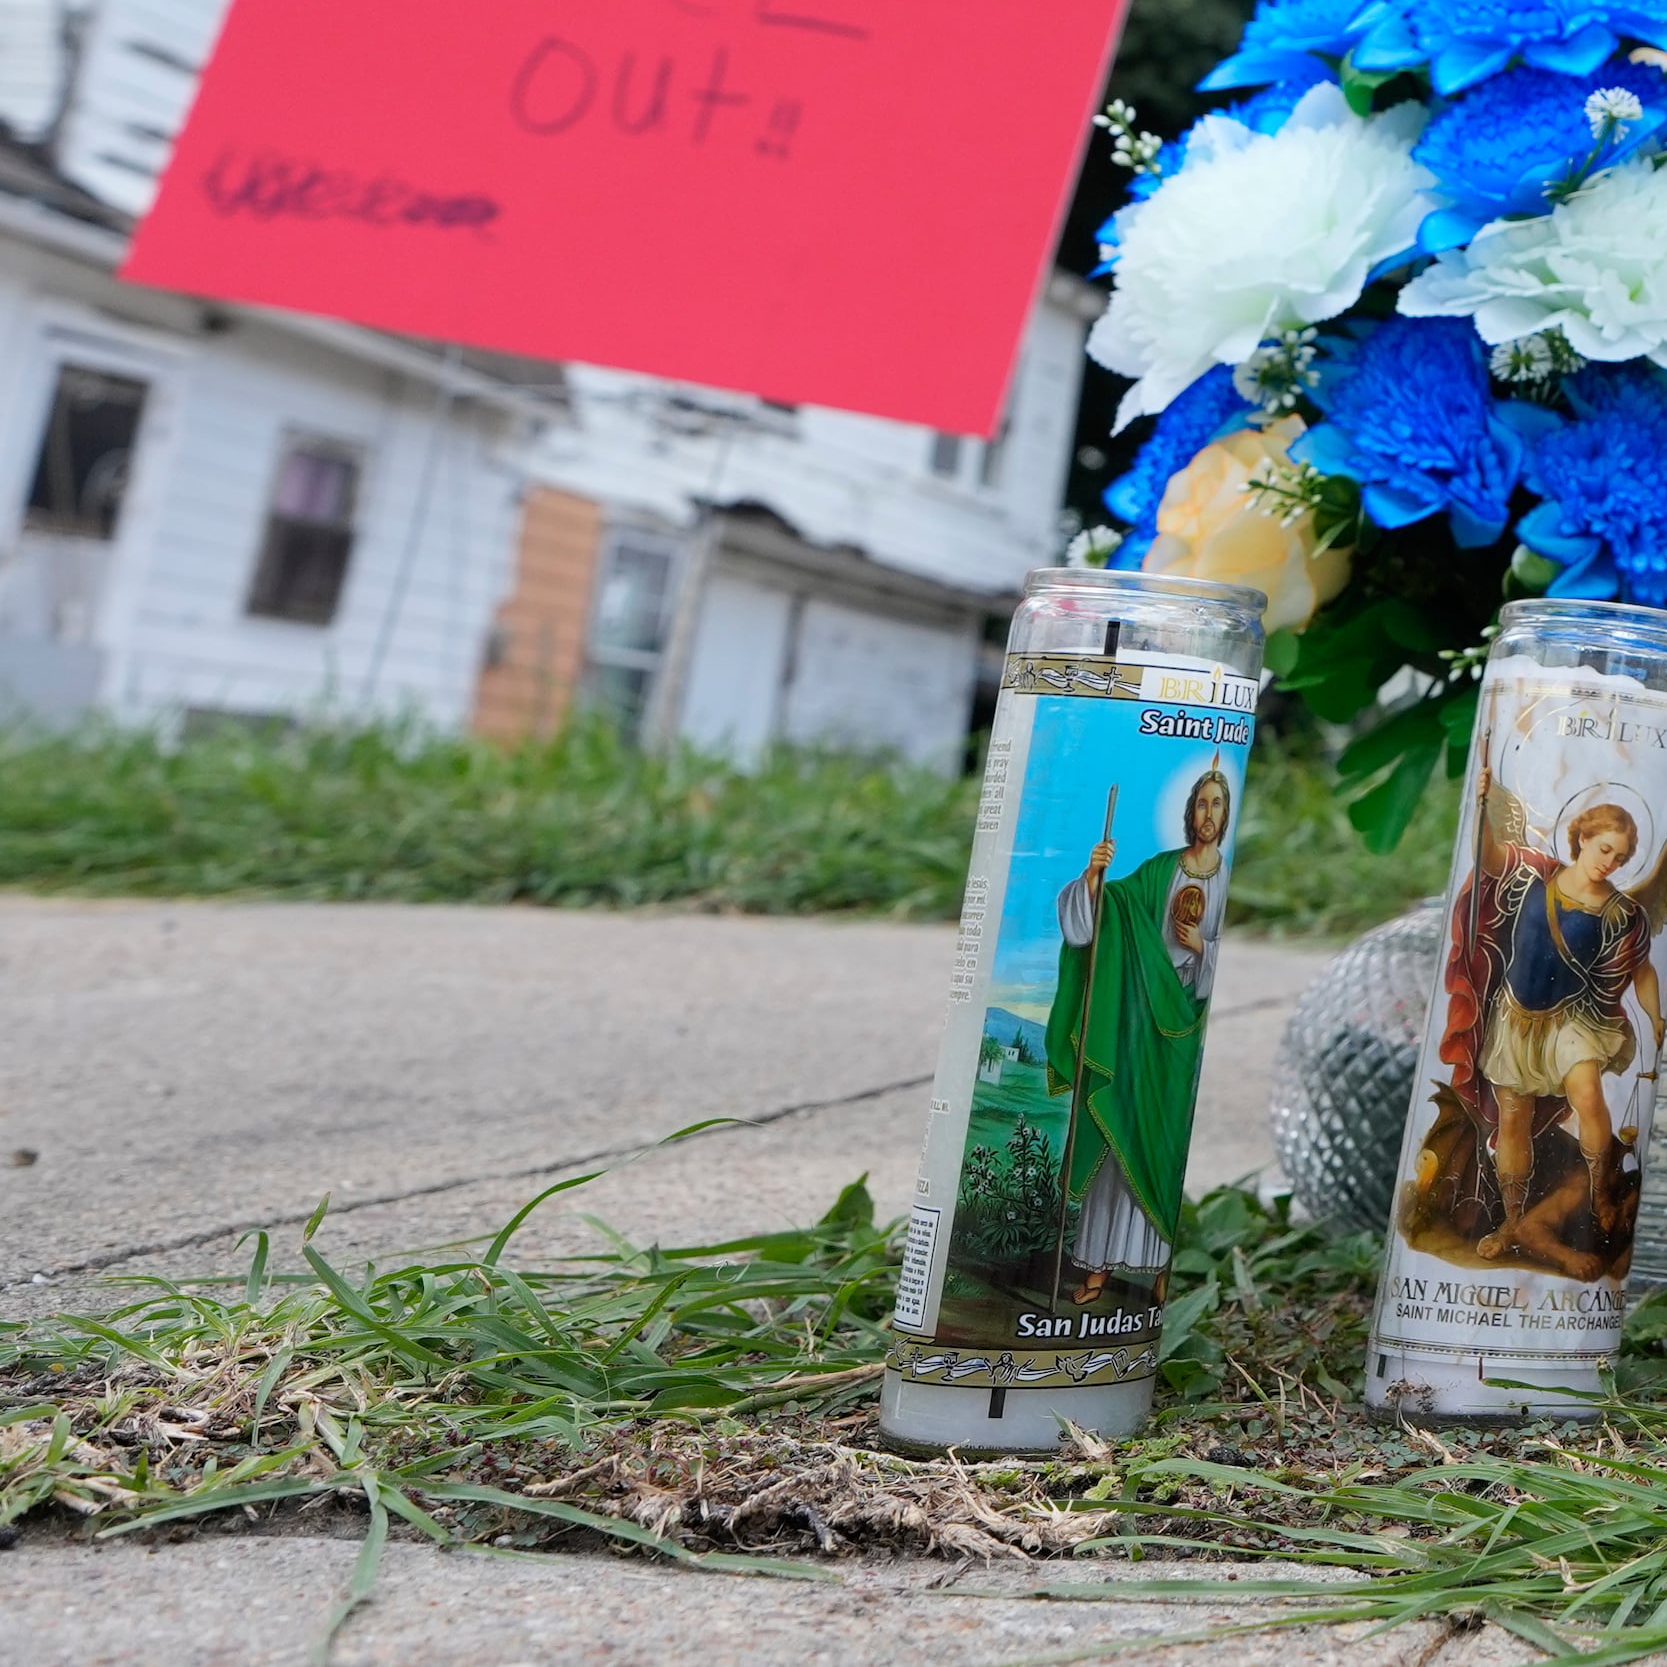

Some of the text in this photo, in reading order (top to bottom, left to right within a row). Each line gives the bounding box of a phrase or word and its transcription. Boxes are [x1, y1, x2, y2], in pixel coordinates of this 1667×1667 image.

[1140, 709, 1251, 745] Saint Jude
[1391, 1276, 1427, 1302] SAN
[1433, 1281, 1528, 1312] MIGUEL
[1016, 1311, 1073, 1339] San
[1077, 1306, 1145, 1340] Judas
[1395, 1302, 1434, 1322] SAINT
[1436, 1308, 1513, 1328] MICHAEL
[1518, 1314, 1551, 1330] THE
